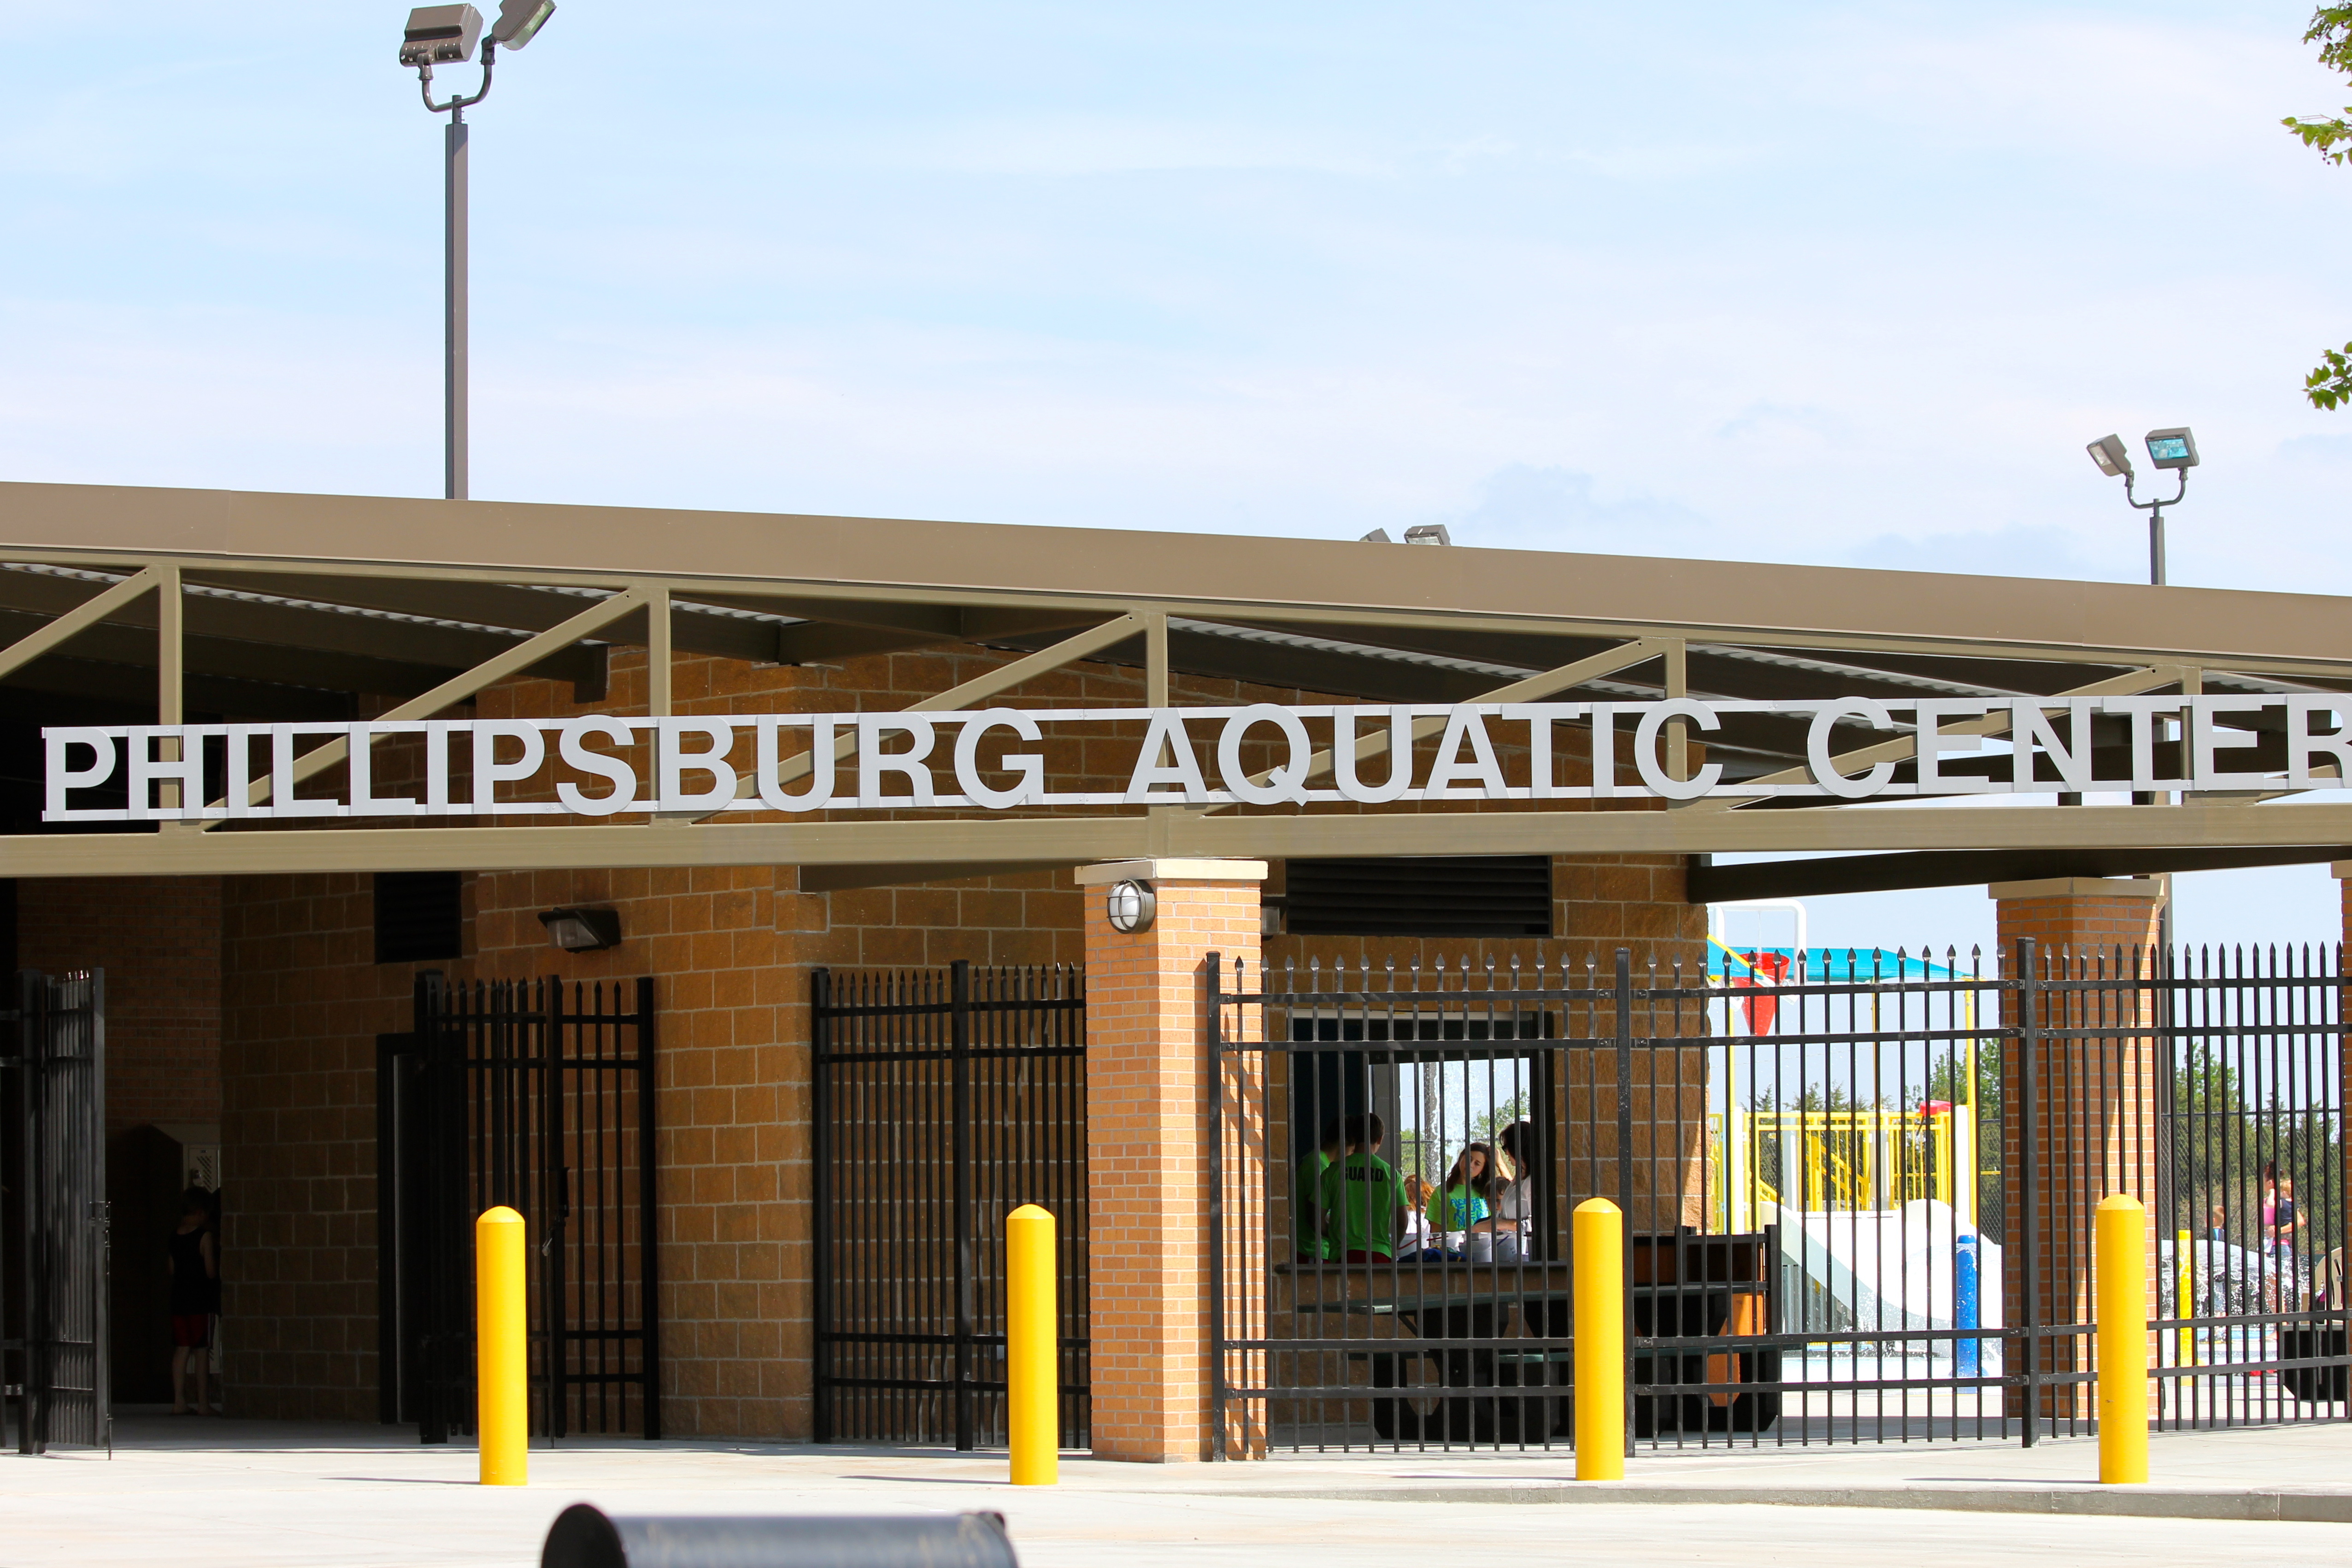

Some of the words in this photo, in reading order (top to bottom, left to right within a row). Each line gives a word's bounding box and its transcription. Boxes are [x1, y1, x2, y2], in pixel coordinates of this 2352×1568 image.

[46, 707, 1044, 822] PHILLIPSBURG
[1123, 697, 1723, 807] AQUATIC
[1807, 694, 2352, 799] CENTER
